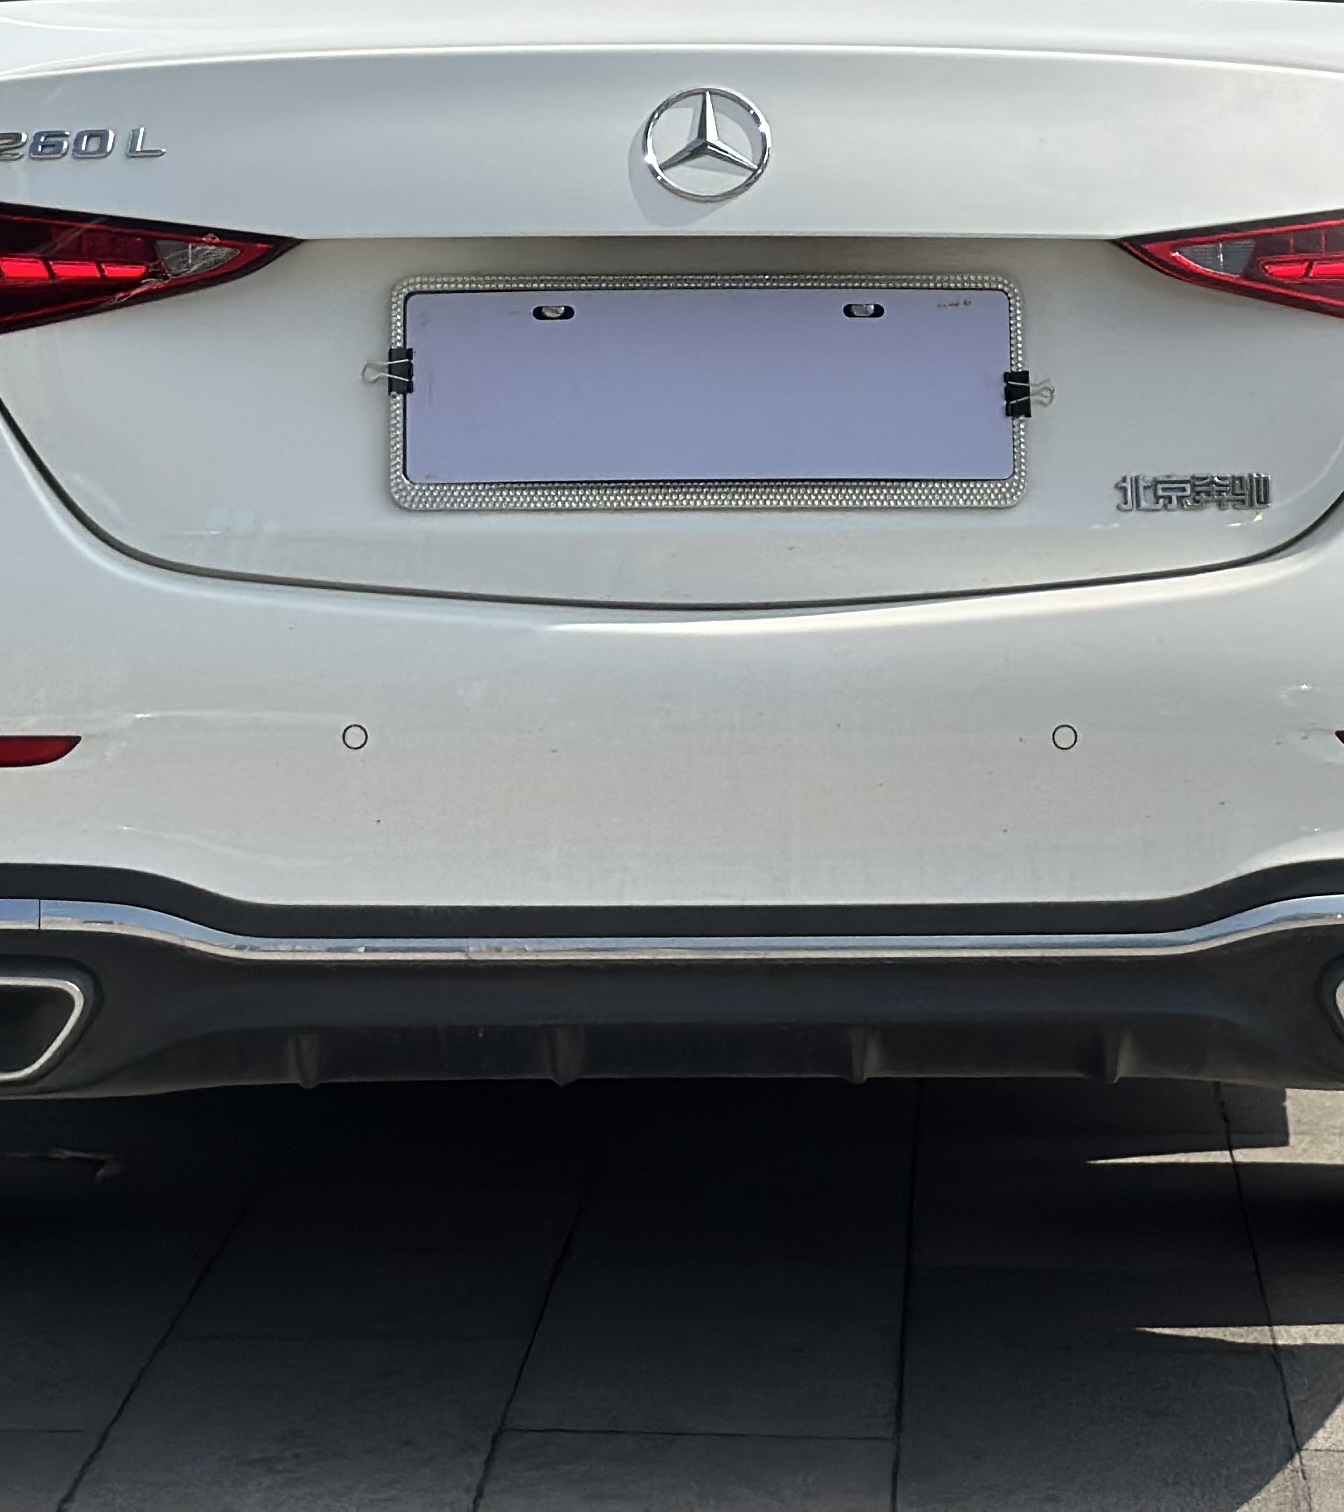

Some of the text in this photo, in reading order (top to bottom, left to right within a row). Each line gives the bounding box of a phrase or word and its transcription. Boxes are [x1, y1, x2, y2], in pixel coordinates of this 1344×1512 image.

[125, 124, 167, 159] L
[1114, 473, 1272, 512] 北京奔驰
